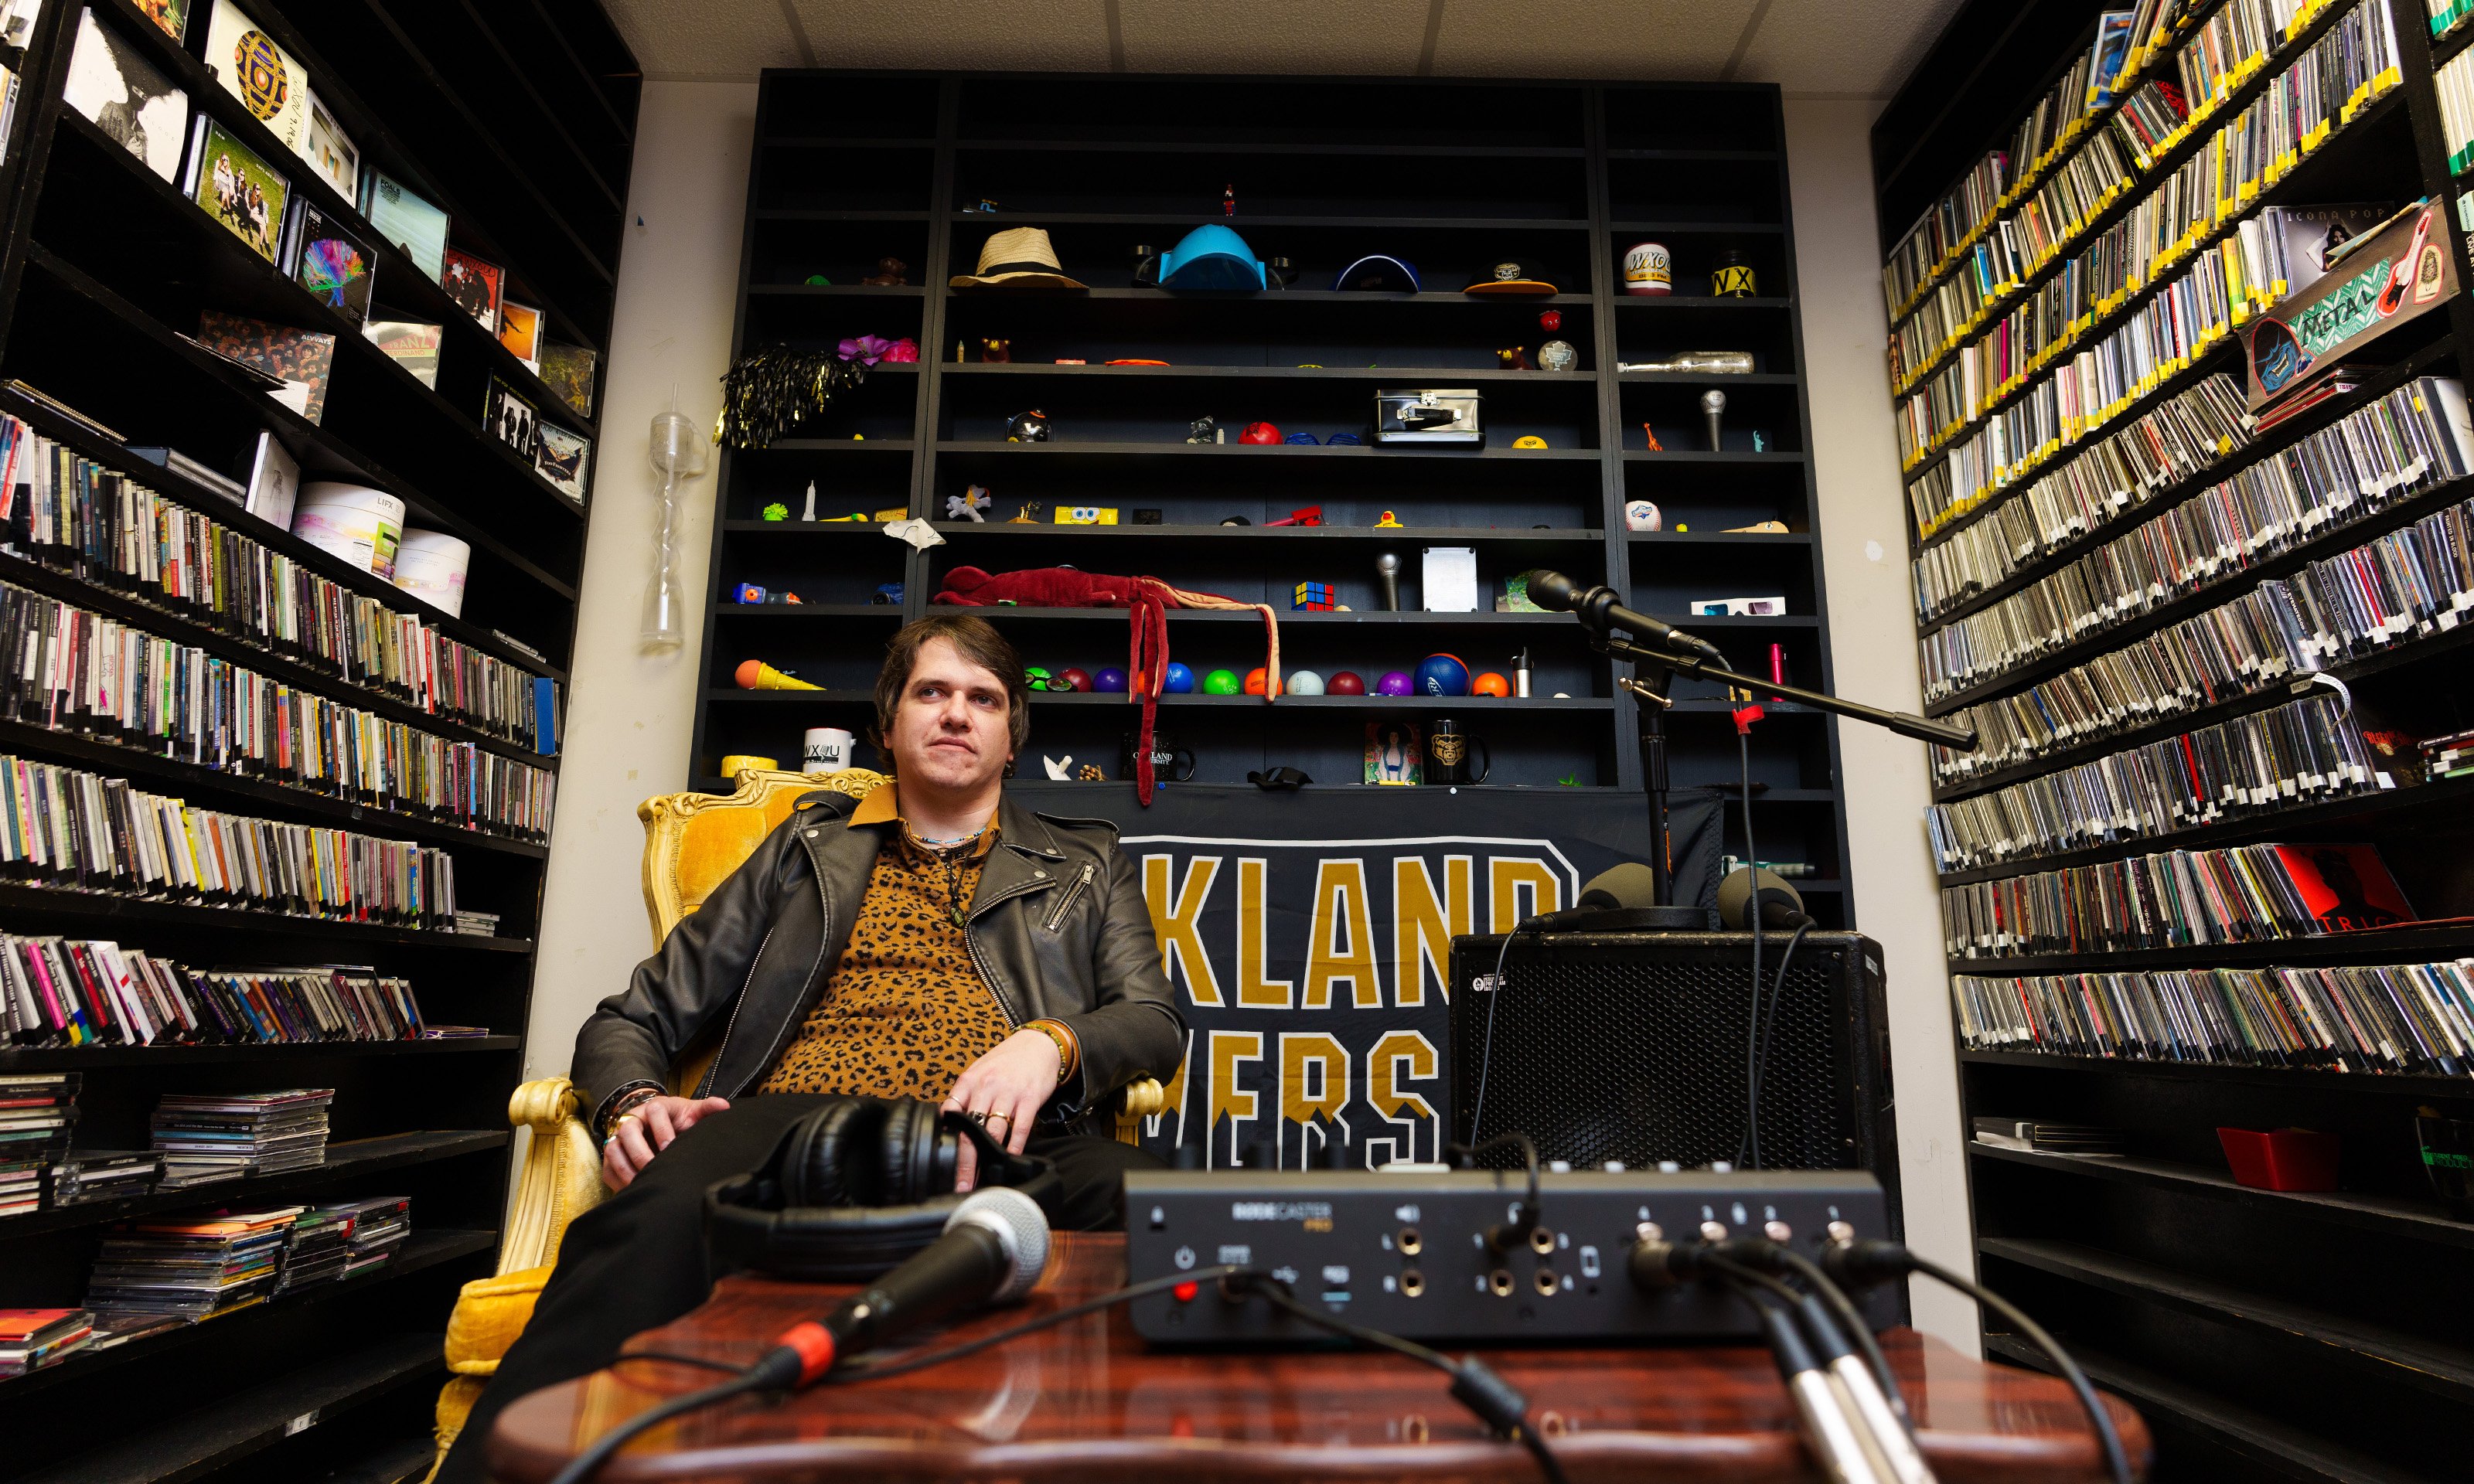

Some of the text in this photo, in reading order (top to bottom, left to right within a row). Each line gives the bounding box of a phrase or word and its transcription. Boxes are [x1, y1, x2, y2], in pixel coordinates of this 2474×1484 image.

[380, 179, 400, 195] FOALS
[309, 210, 322, 223] MUSE
[2287, 208, 2385, 223] ICONA POP
[2301, 290, 2377, 347] METAL
[389, 335, 430, 349] FRANZ
[387, 349, 425, 357] FERDINAND
[377, 497, 394, 510] LIFX
[2444, 515, 2453, 535] PAINTED
[2287, 592, 2305, 631] EYEHATEGOD
[2292, 681, 2311, 692] METAL
[2317, 916, 2390, 933] TRIC
[2, 955, 11, 979] FREQUENCY
[7, 985, 15, 1001] STEREO
